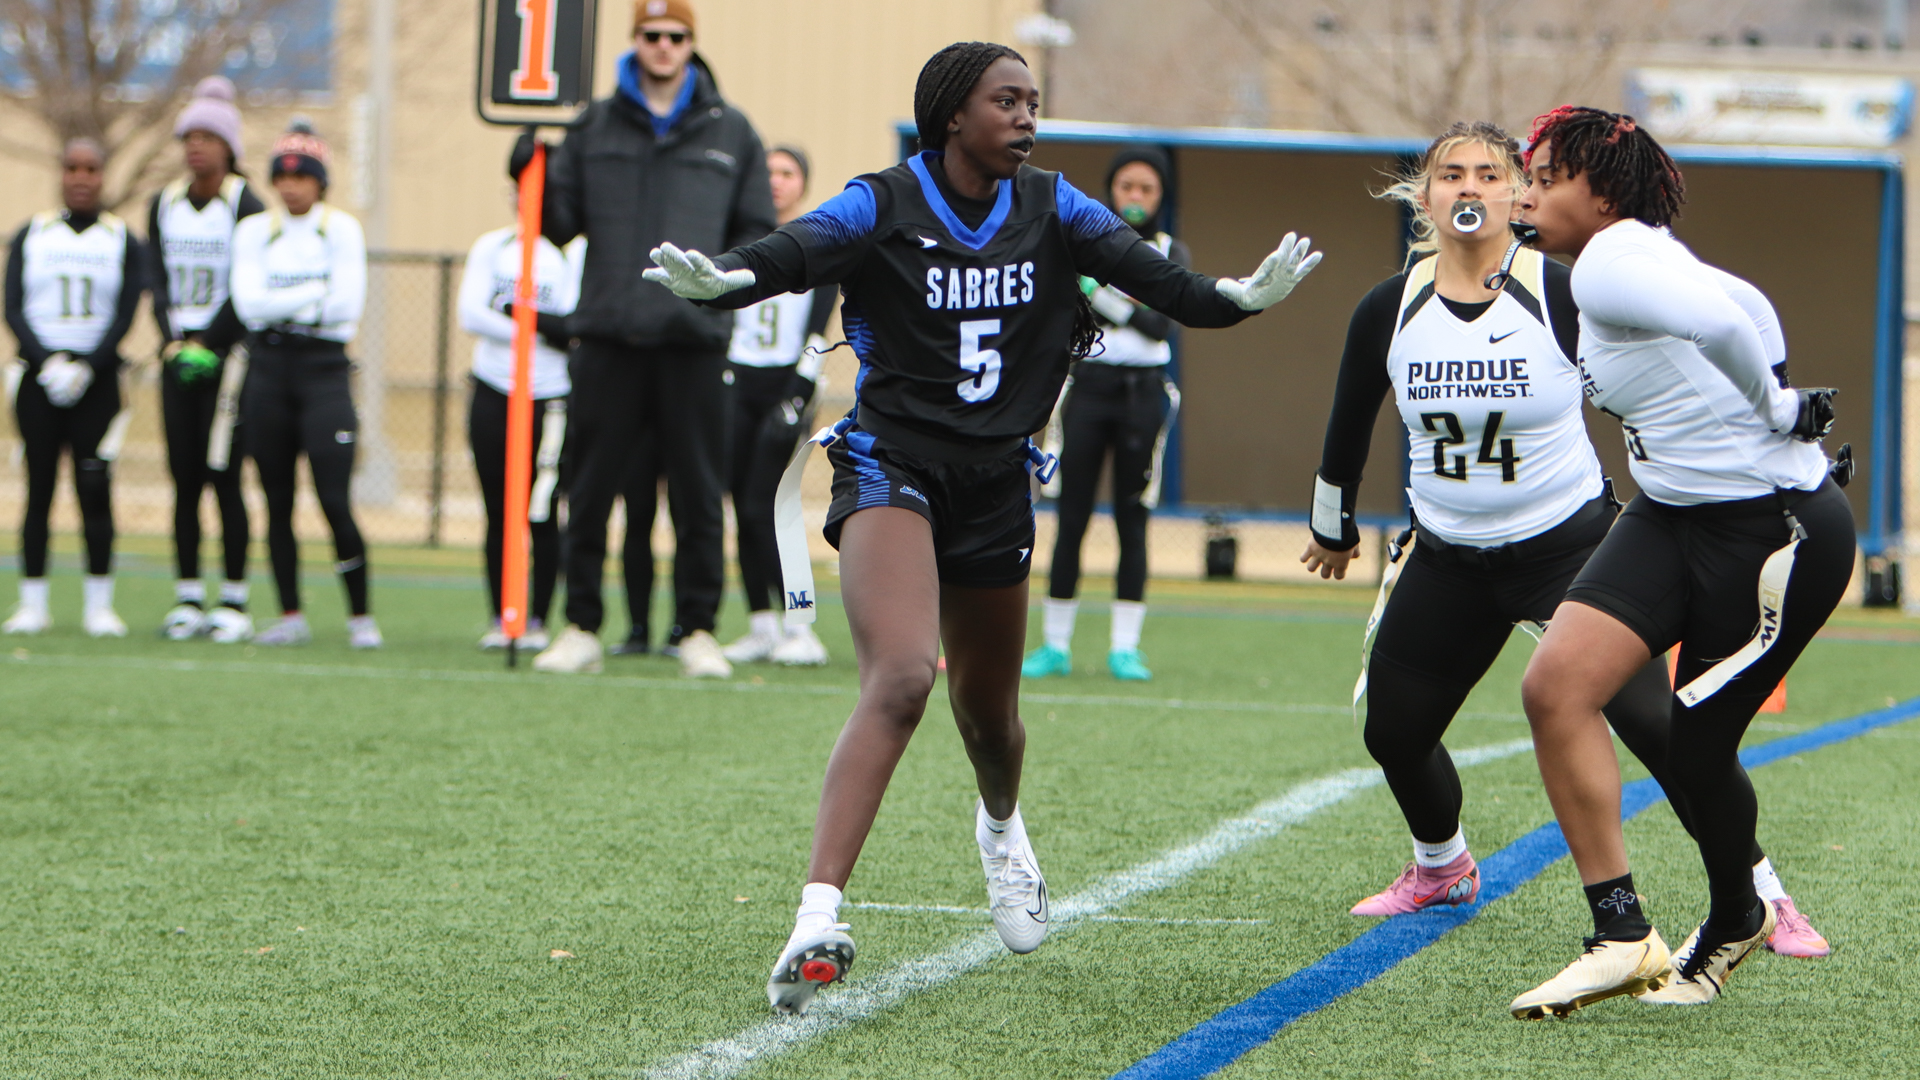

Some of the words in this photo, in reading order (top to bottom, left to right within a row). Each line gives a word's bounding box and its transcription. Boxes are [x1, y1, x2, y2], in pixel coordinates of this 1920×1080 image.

[509, 0, 560, 100] 1
[57, 275, 93, 318] 11
[926, 261, 1034, 310] SABRES
[757, 302, 779, 349] 9
[957, 319, 1002, 402] 5
[1407, 358, 1530, 385] PURDUE
[1419, 410, 1521, 484] 24
[1759, 588, 1780, 650] PNW
